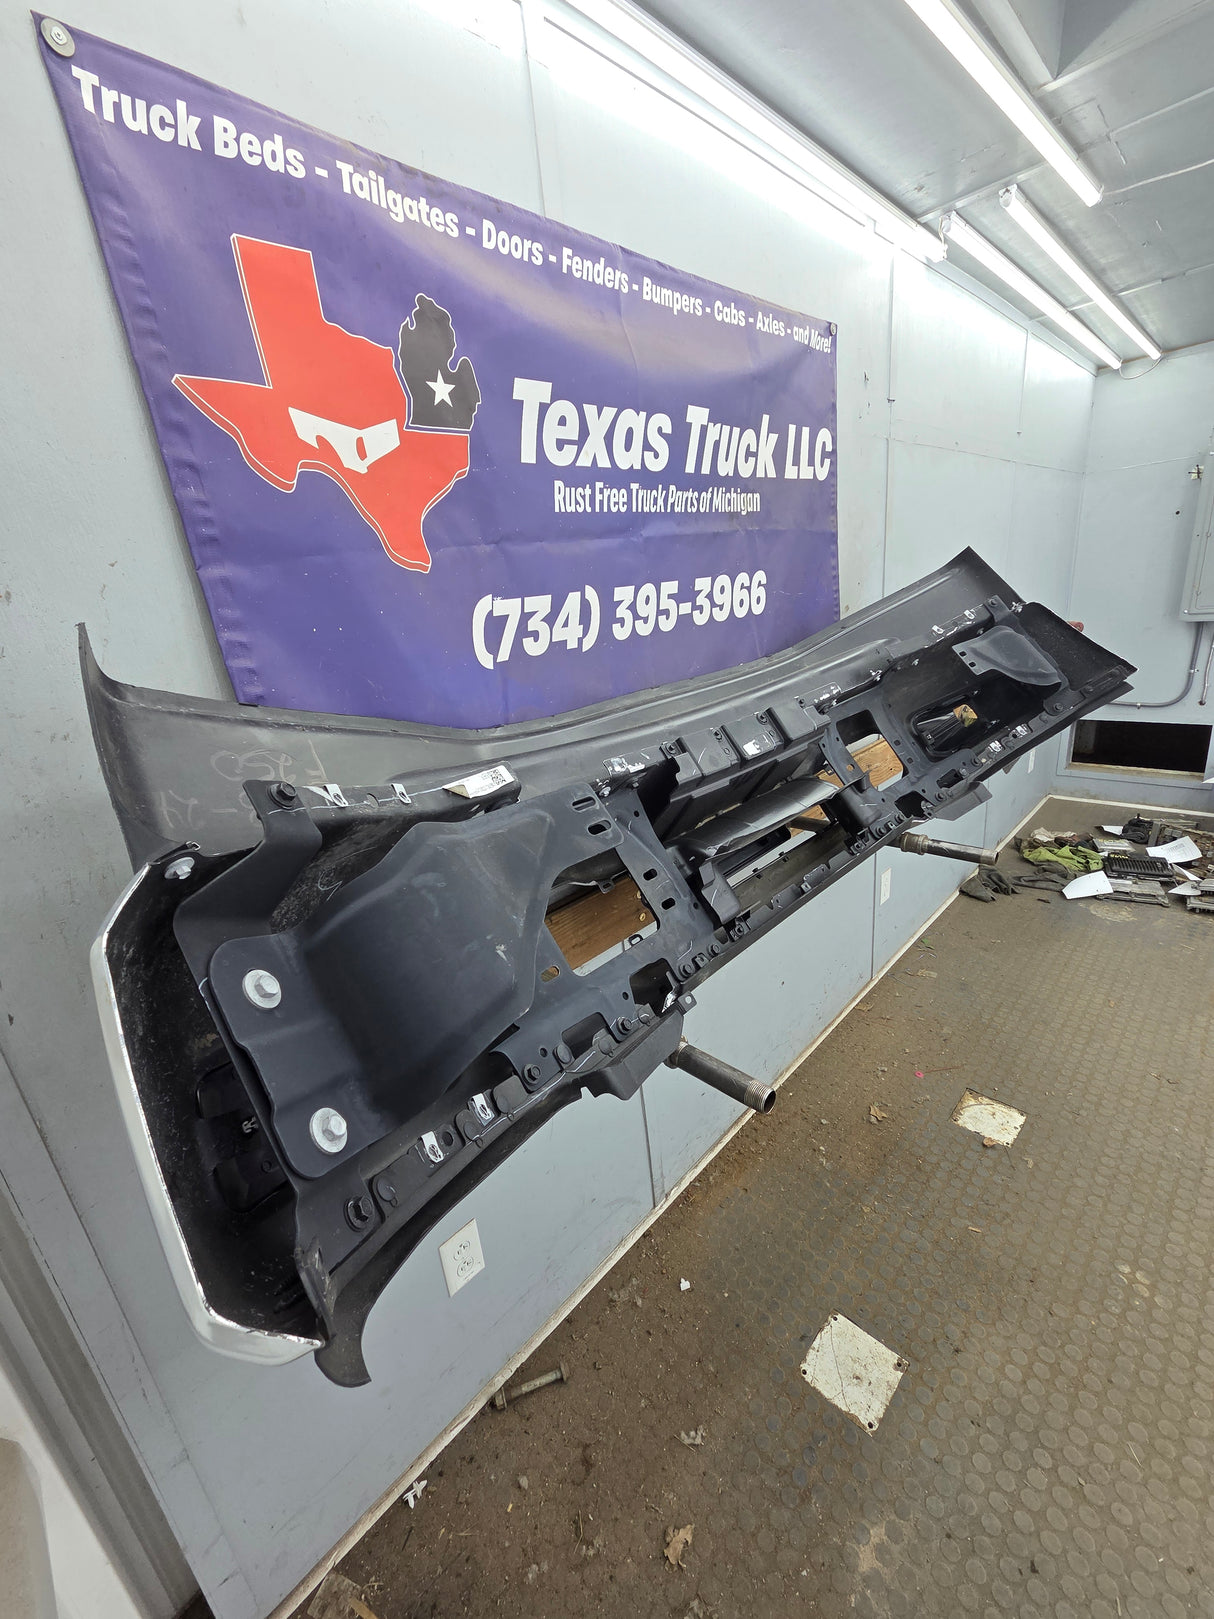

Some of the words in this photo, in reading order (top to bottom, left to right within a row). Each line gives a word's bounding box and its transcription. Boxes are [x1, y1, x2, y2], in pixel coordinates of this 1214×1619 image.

[71, 65, 202, 151] Truck
[214, 115, 306, 179] Beds
[315, 167, 328, 179] -
[336, 160, 459, 239] Tailgates
[482, 218, 544, 265] Doors
[562, 247, 629, 293] Fenders
[643, 277, 702, 316] Bumpers
[714, 300, 746, 327] Cabs
[756, 311, 785, 337] Axles
[793, 326, 809, 346] and
[810, 329, 832, 353] More!
[512, 377, 672, 472] Texas
[685, 404, 778, 478] Truck
[784, 424, 833, 481] LLC
[554, 480, 592, 513] Rust
[595, 481, 627, 513] Free
[630, 483, 666, 513] Truck
[667, 486, 699, 513] Parts
[700, 488, 712, 513] of
[712, 489, 761, 515] Michigan
[471, 584, 601, 669] (734)
[612, 570, 767, 641] 395-3966
